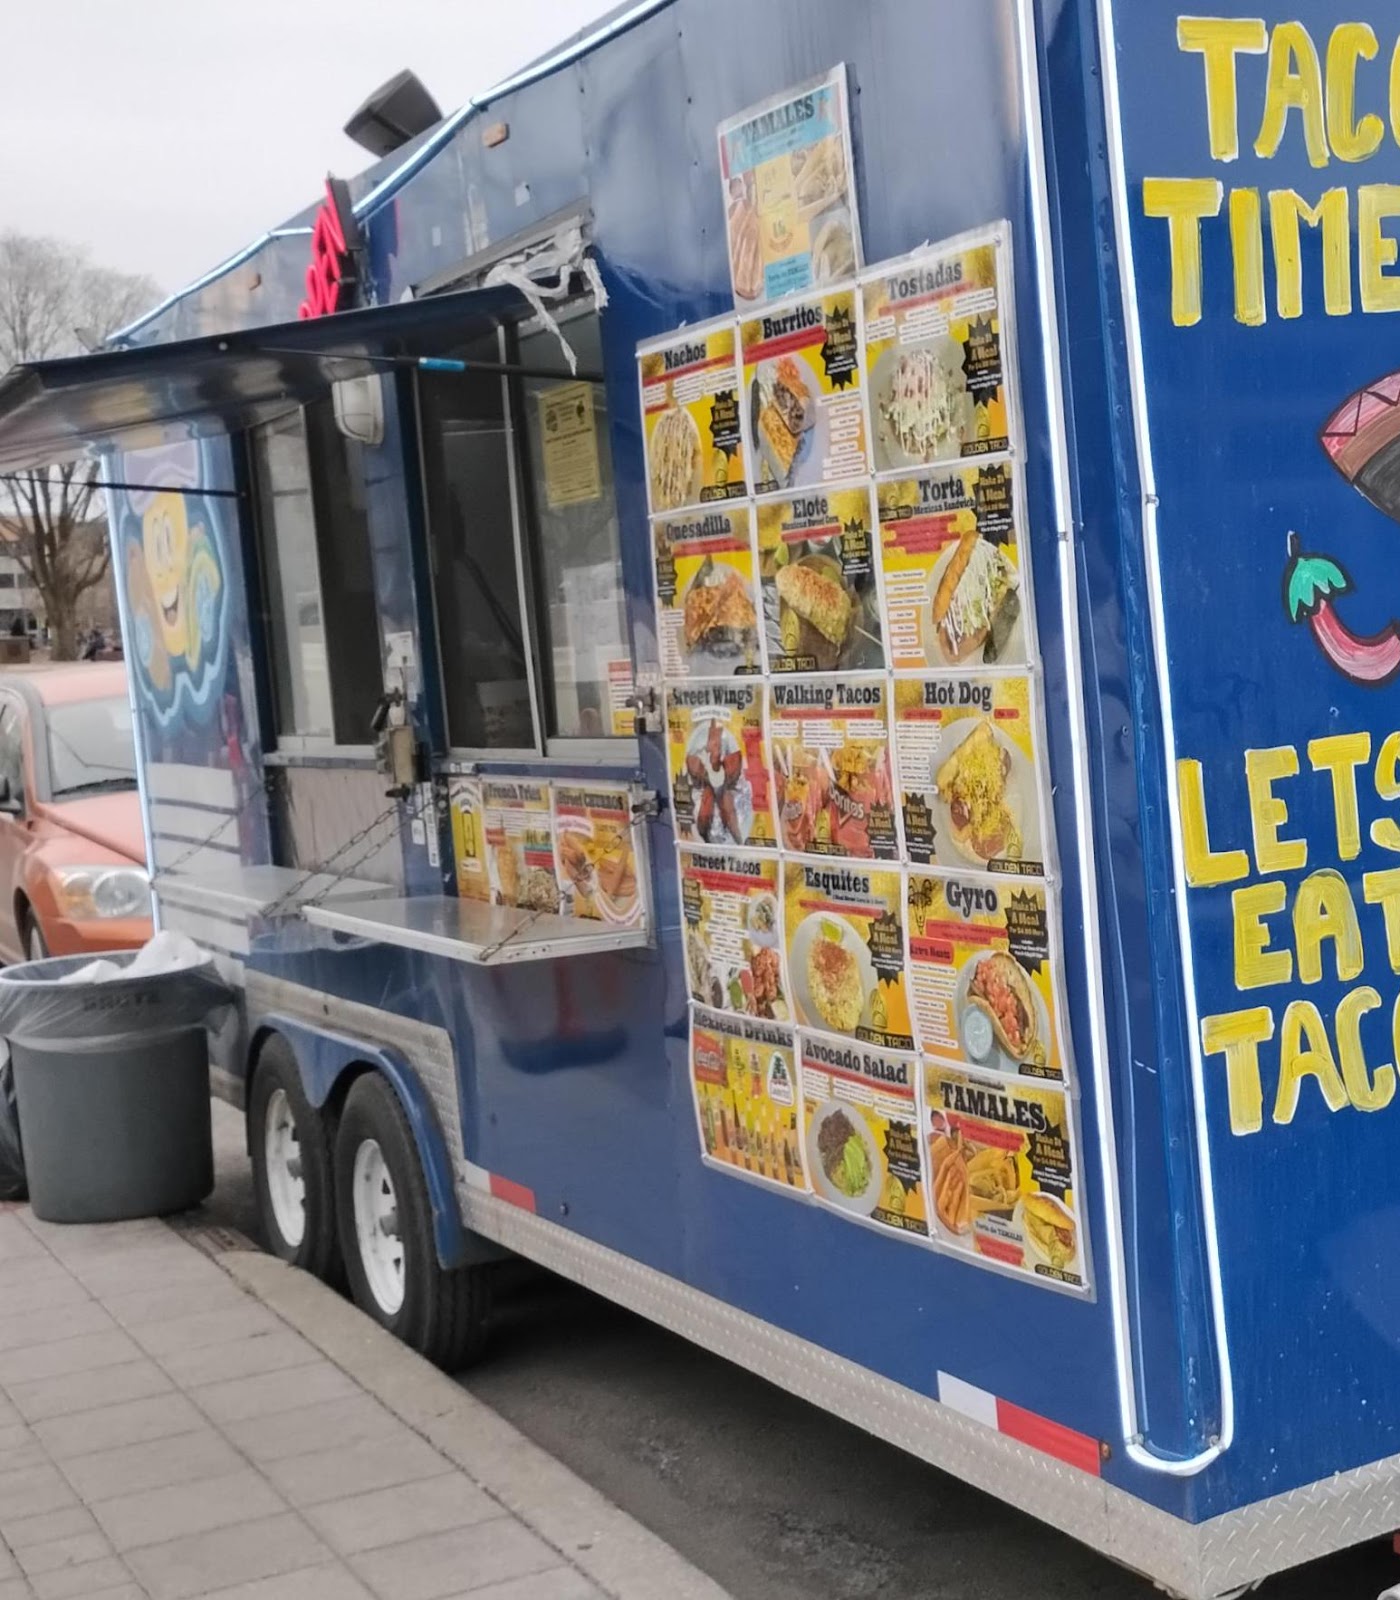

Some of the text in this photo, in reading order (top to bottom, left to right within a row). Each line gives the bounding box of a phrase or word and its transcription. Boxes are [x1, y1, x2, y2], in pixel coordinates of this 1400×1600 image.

[741, 95, 815, 146] TAMALES
[887, 261, 963, 300] Tostadas
[763, 306, 822, 339] Burritos
[665, 343, 707, 369] Nachos
[963, 438, 1009, 457] GOLDEN TACO
[919, 476, 965, 502] Torta
[792, 498, 829, 518] Elote
[914, 502, 943, 515] Mexican
[666, 515, 731, 540] Quesadilla
[672, 685, 754, 710] Street Wings
[774, 684, 881, 709] Walking Tacos
[925, 682, 992, 711] Hot Dog
[692, 853, 761, 875] Street Tacos
[989, 860, 1042, 875] GOLDEN TACO
[805, 867, 870, 895] Esquites
[946, 881, 997, 918] Gyro
[744, 1023, 793, 1048] Drinks
[858, 1028, 913, 1049] GOLDEN TACO
[805, 1039, 908, 1084] Avocado Salad
[940, 1081, 1046, 1131] TAMALES
[874, 1208, 928, 1235] GOLDEN TACO
[1037, 1265, 1082, 1285] GOLDEN TACO
